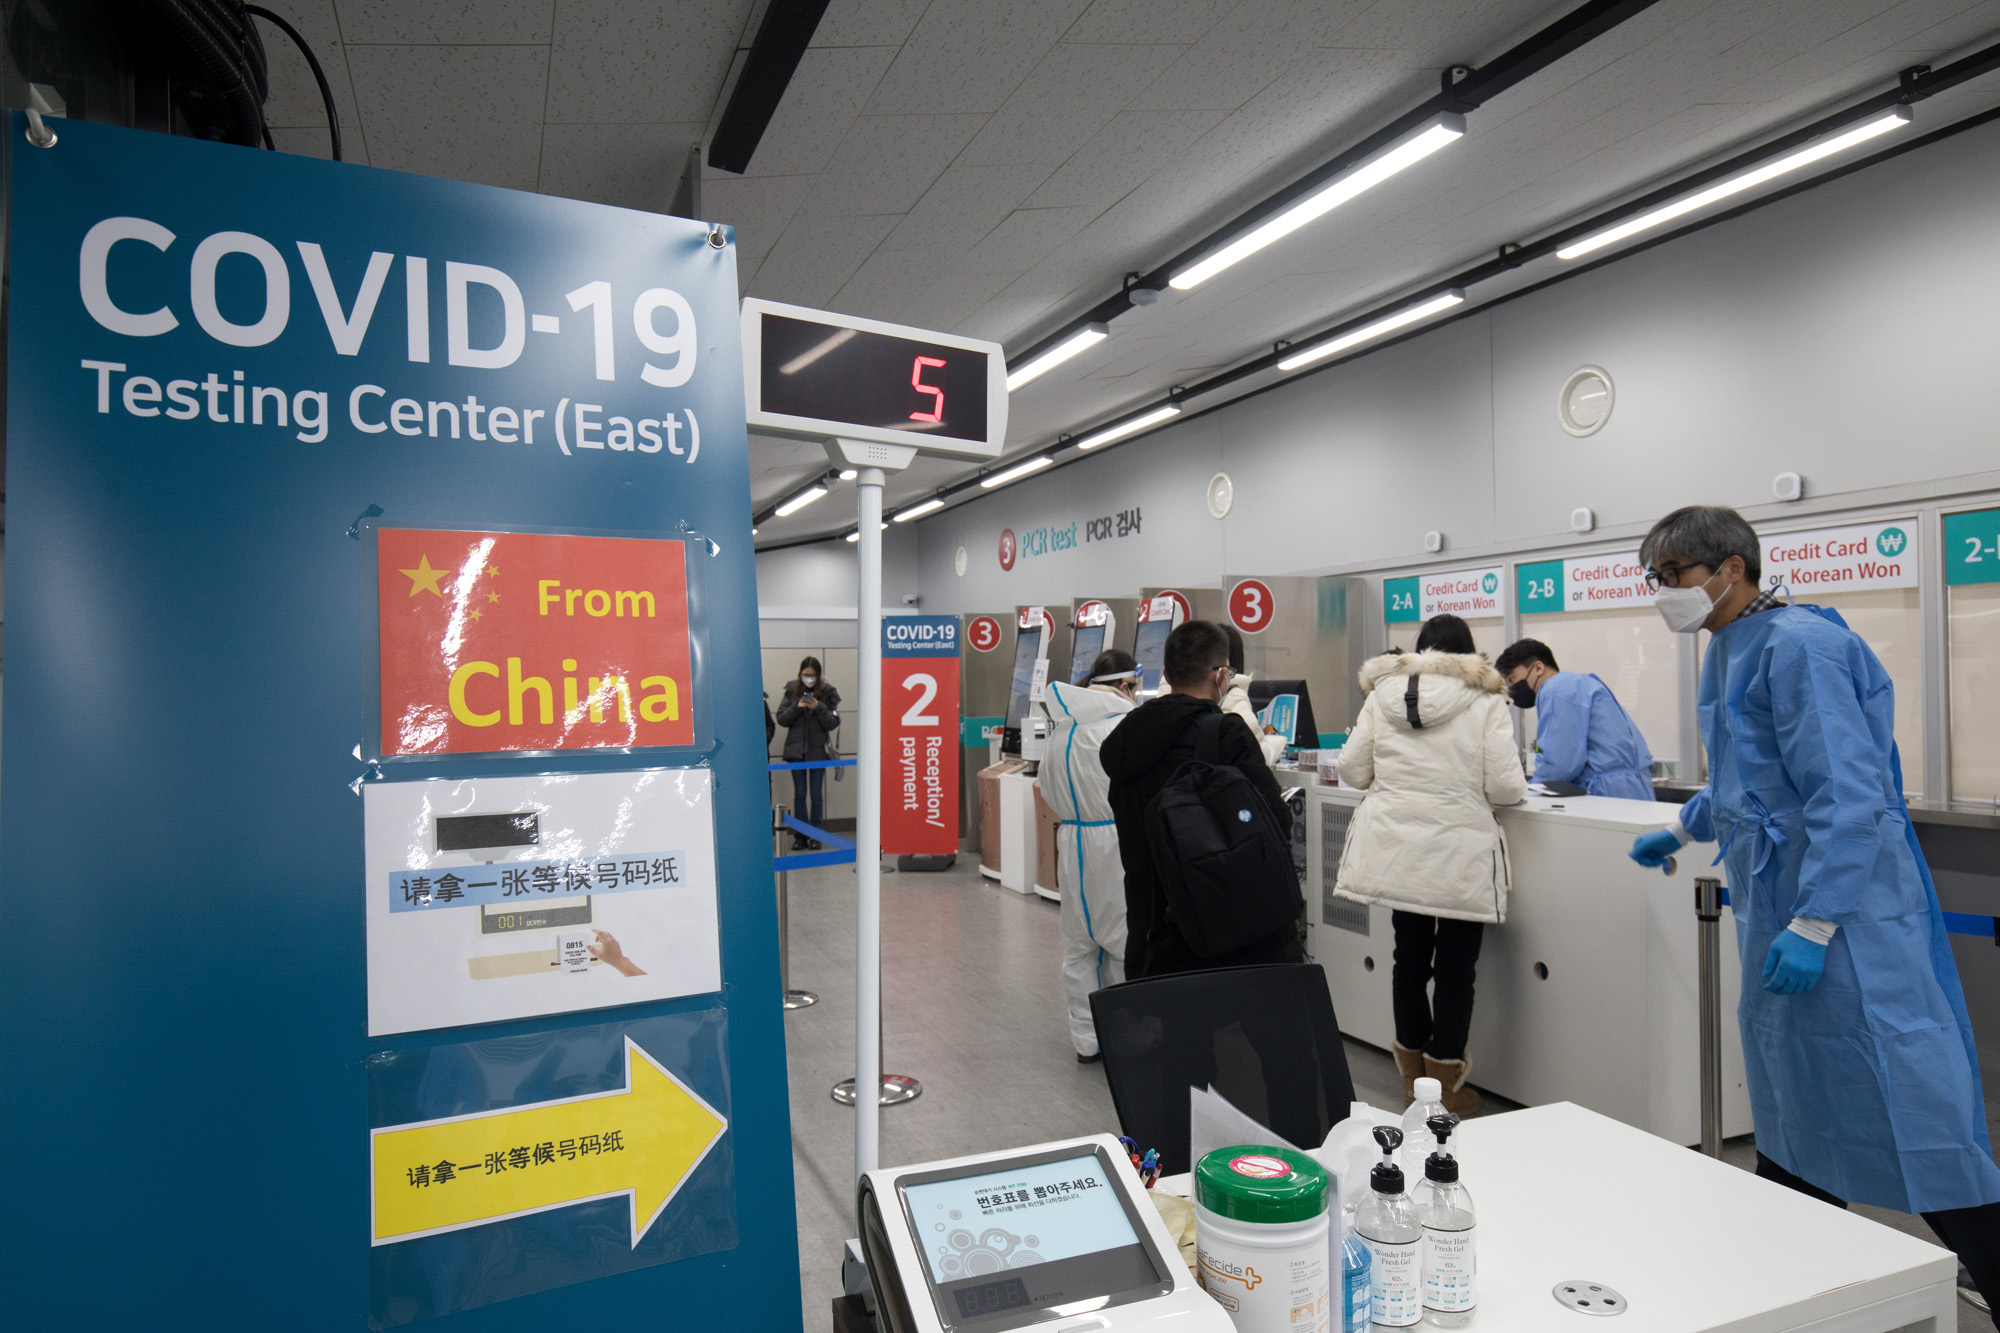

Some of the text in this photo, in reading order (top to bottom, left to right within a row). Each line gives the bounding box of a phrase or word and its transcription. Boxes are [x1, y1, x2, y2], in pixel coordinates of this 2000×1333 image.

[79, 216, 698, 388] COVID-19
[909, 355, 947, 423] 5
[81, 359, 700, 464] Testing Center (East)
[1003, 507, 1142, 564] 3 PCR test PCR 검사
[1770, 543, 1821, 562] Credit
[1826, 537, 1868, 558] Card
[1964, 534, 2000, 563] 2-
[1572, 564, 1643, 582] Credit Card
[1769, 562, 1901, 586] or Korean Won
[538, 579, 656, 618] From
[1425, 582, 1453, 596] Credit
[1456, 579, 1478, 594] Card
[1528, 578, 1555, 599] 2-B
[1572, 582, 1657, 601] or Korean Wo
[1242, 587, 1262, 624] 3
[1391, 592, 1413, 610] 2-A
[1426, 597, 1495, 613] or Korean Won
[886, 624, 955, 641] COVID-19
[977, 621, 993, 645] 3
[887, 641, 955, 650] Testing Center (East)
[448, 656, 680, 728] China
[901, 673, 939, 726] 2
[899, 737, 919, 811] payment
[925, 736, 945, 828] Reception/
[400, 856, 680, 907] 请拿一张等候号码纸
[498, 915, 522, 929] 001
[566, 941, 583, 949] 0815
[406, 1130, 625, 1189] 请拿一张等候号码纸
[976, 1177, 1103, 1209] 번호표를 뽑아주세요.
[1428, 1235, 1469, 1245] Wonder Hand
[1434, 1244, 1453, 1253] Fresh
[1374, 1248, 1416, 1258] Wonder Hand
[1381, 1258, 1399, 1266] Fresh
